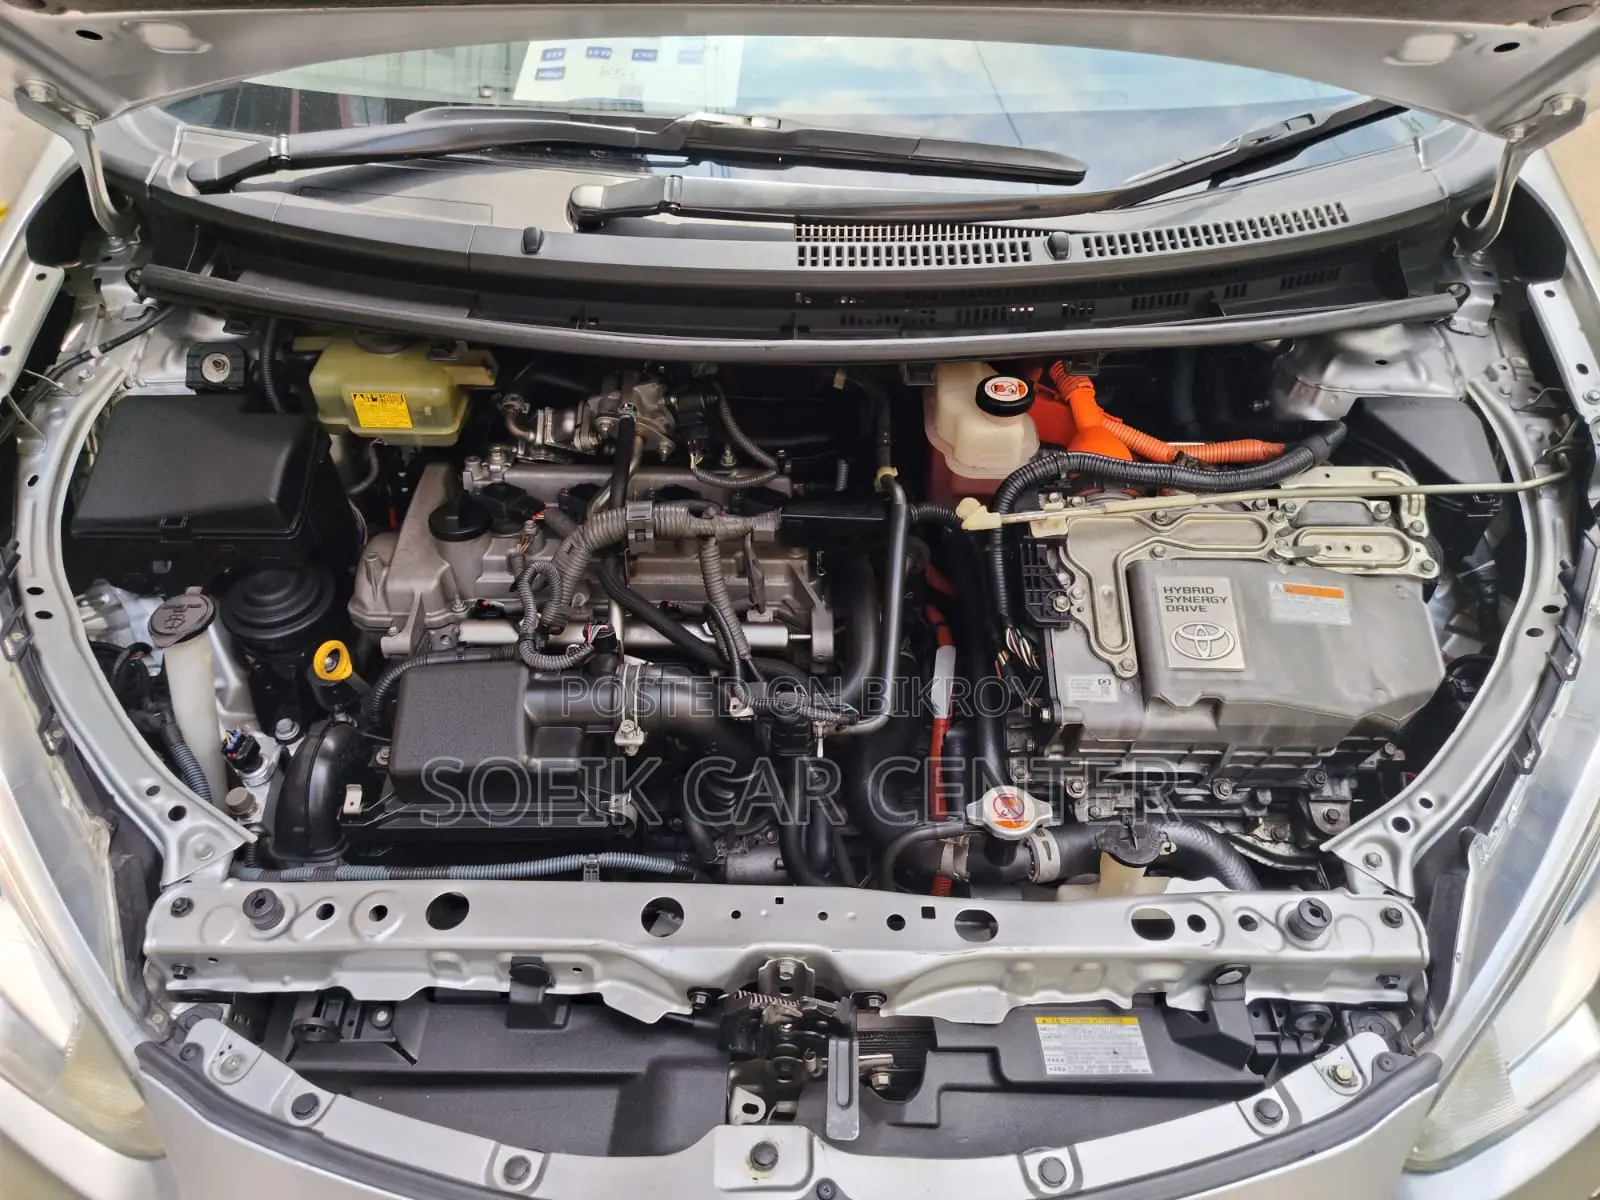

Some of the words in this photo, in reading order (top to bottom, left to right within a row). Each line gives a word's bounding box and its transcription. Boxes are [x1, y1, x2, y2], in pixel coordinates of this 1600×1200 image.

[1163, 586, 1215, 595] HYBRID
[1164, 595, 1228, 604] SYNERGY
[1166, 604, 1208, 613] DRIVE
